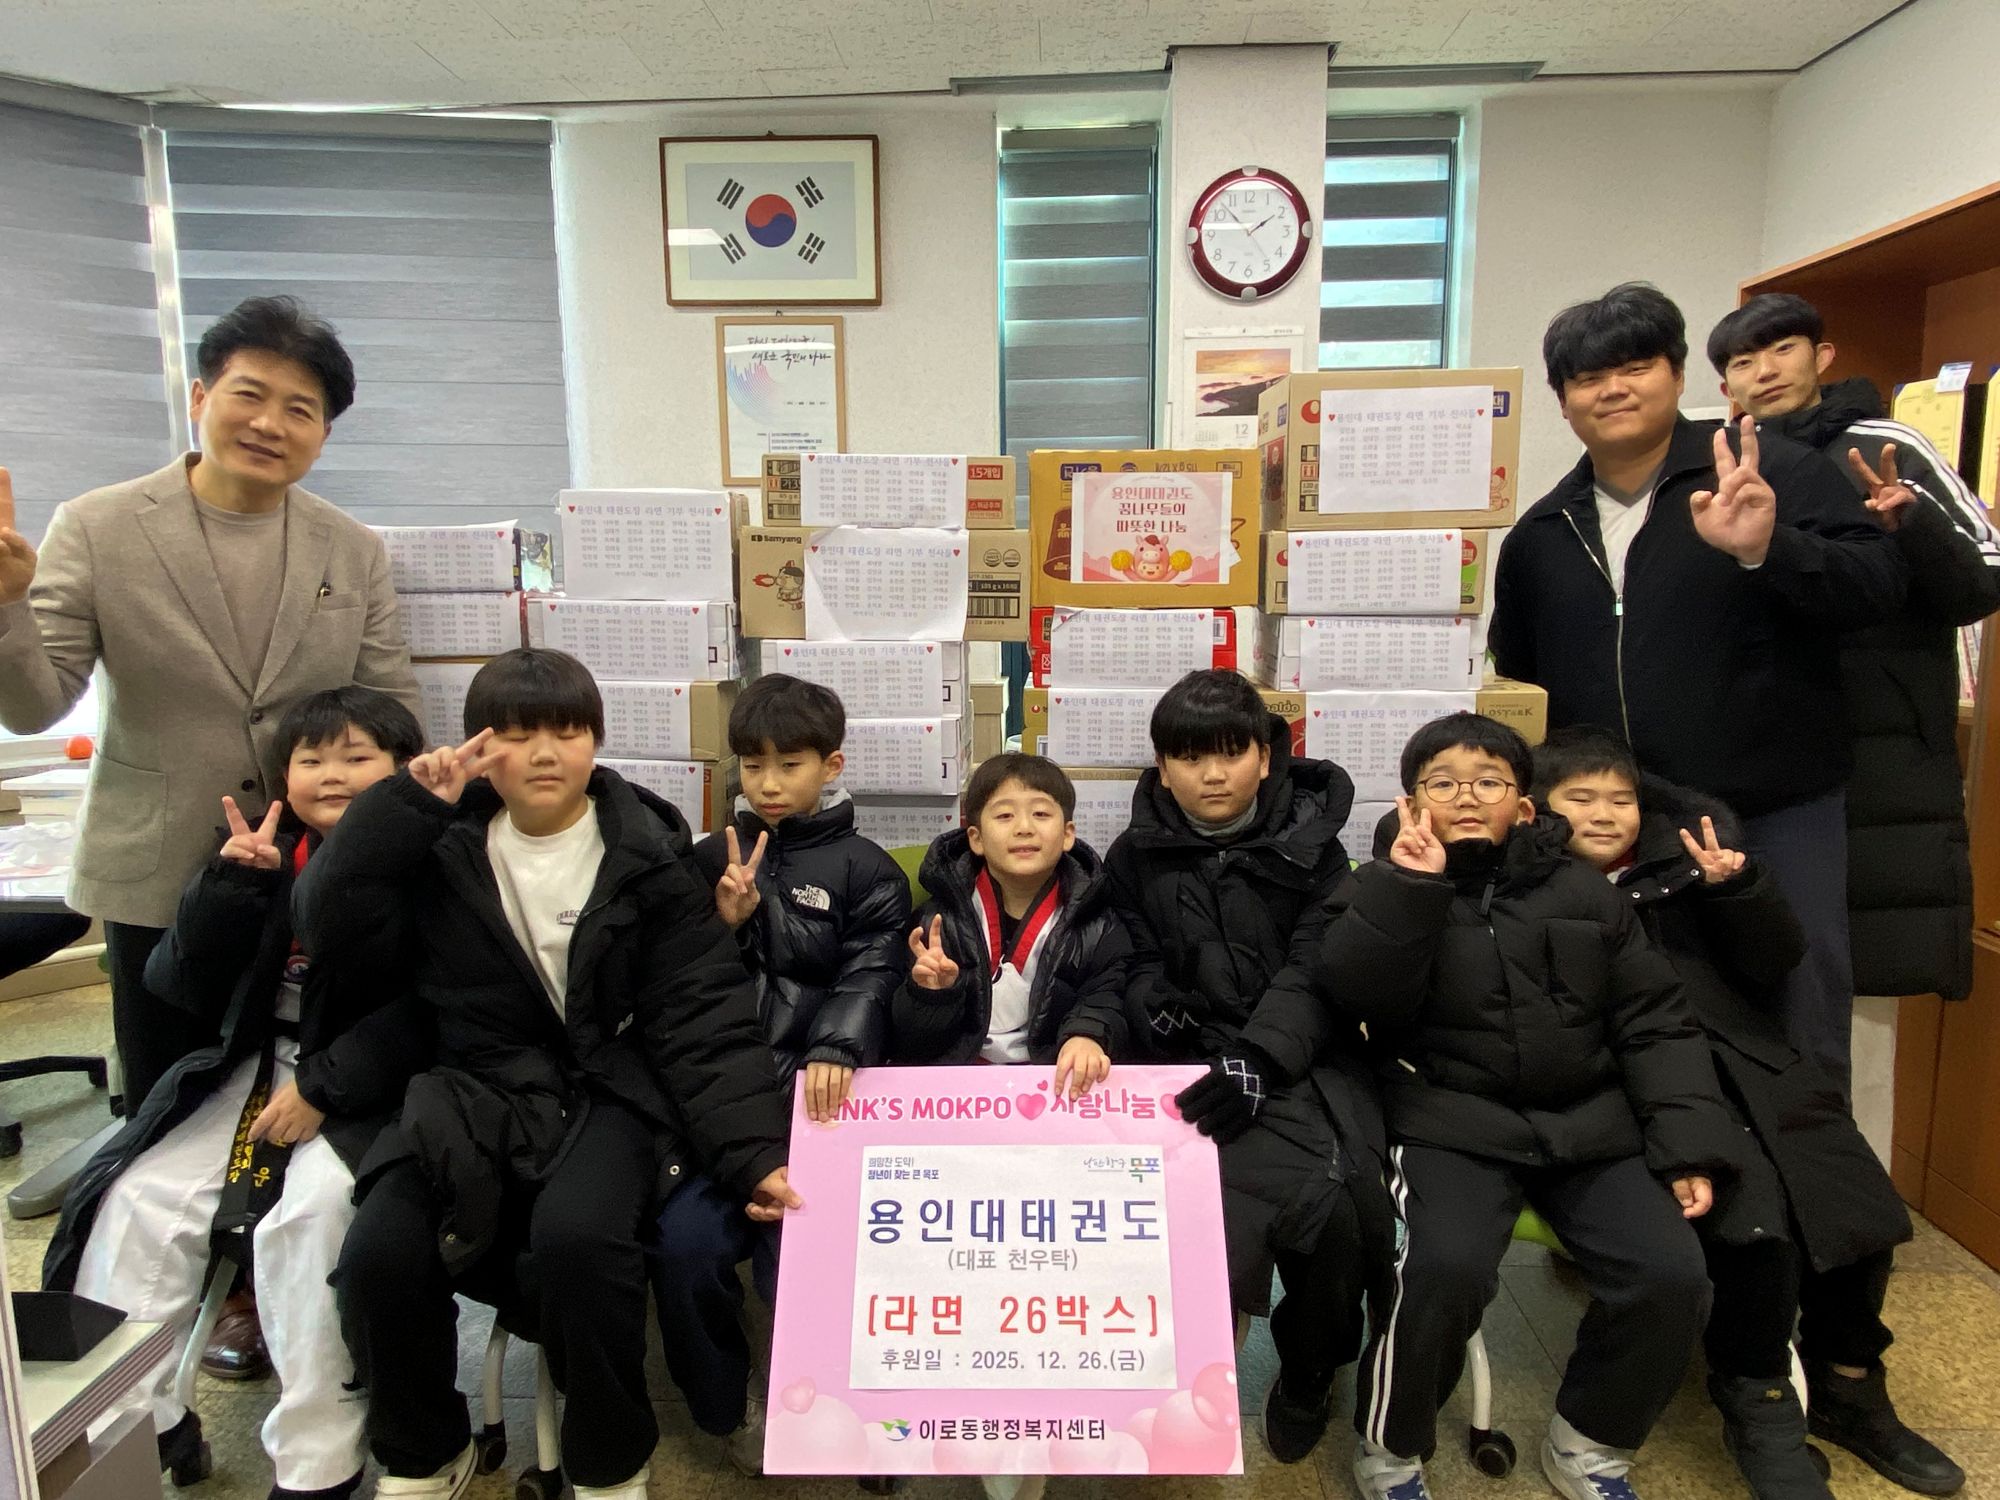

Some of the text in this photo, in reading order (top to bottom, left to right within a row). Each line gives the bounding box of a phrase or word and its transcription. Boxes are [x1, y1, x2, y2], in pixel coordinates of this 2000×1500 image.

[1228, 194, 1237, 207] 11
[1244, 190, 1256, 204] 12
[1265, 192, 1270, 205] 1
[1214, 209, 1226, 222] 10
[1278, 206, 1286, 219] 2
[1207, 230, 1216, 241] 9
[1282, 225, 1290, 238] 3
[1214, 248, 1222, 261] 8
[1274, 246, 1284, 258] 4
[1228, 262, 1236, 274] 7
[1244, 264, 1253, 278] 6
[1263, 260, 1271, 272] 5
[1234, 424, 1249, 435] 12
[970, 467, 1001, 478] 15개입
[1111, 487, 1194, 500] 용인대태권도
[1119, 502, 1186, 516] 꿈나무들의
[1116, 520, 1188, 533] 따뜻한 나눔
[764, 535, 802, 544] Samyang
[912, 1096, 1012, 1120] MOKPO
[1050, 1088, 1156, 1120] 사랑나눔
[868, 1157, 893, 1168] 희망찬
[868, 1169, 940, 1180] 청년이 찾는 큰 목포
[1128, 1157, 1161, 1183] 목포
[867, 1198, 1161, 1244] 용인대태권도
[947, 1248, 1079, 1271] (대표 천우탁)
[880, 1349, 943, 1372] 후원일
[972, 1350, 1025, 1370] 2025.
[1036, 1350, 1066, 1370] 12.
[1078, 1348, 1146, 1372] 26.(금)
[918, 1418, 1106, 1442] 이로동행정복지센터
